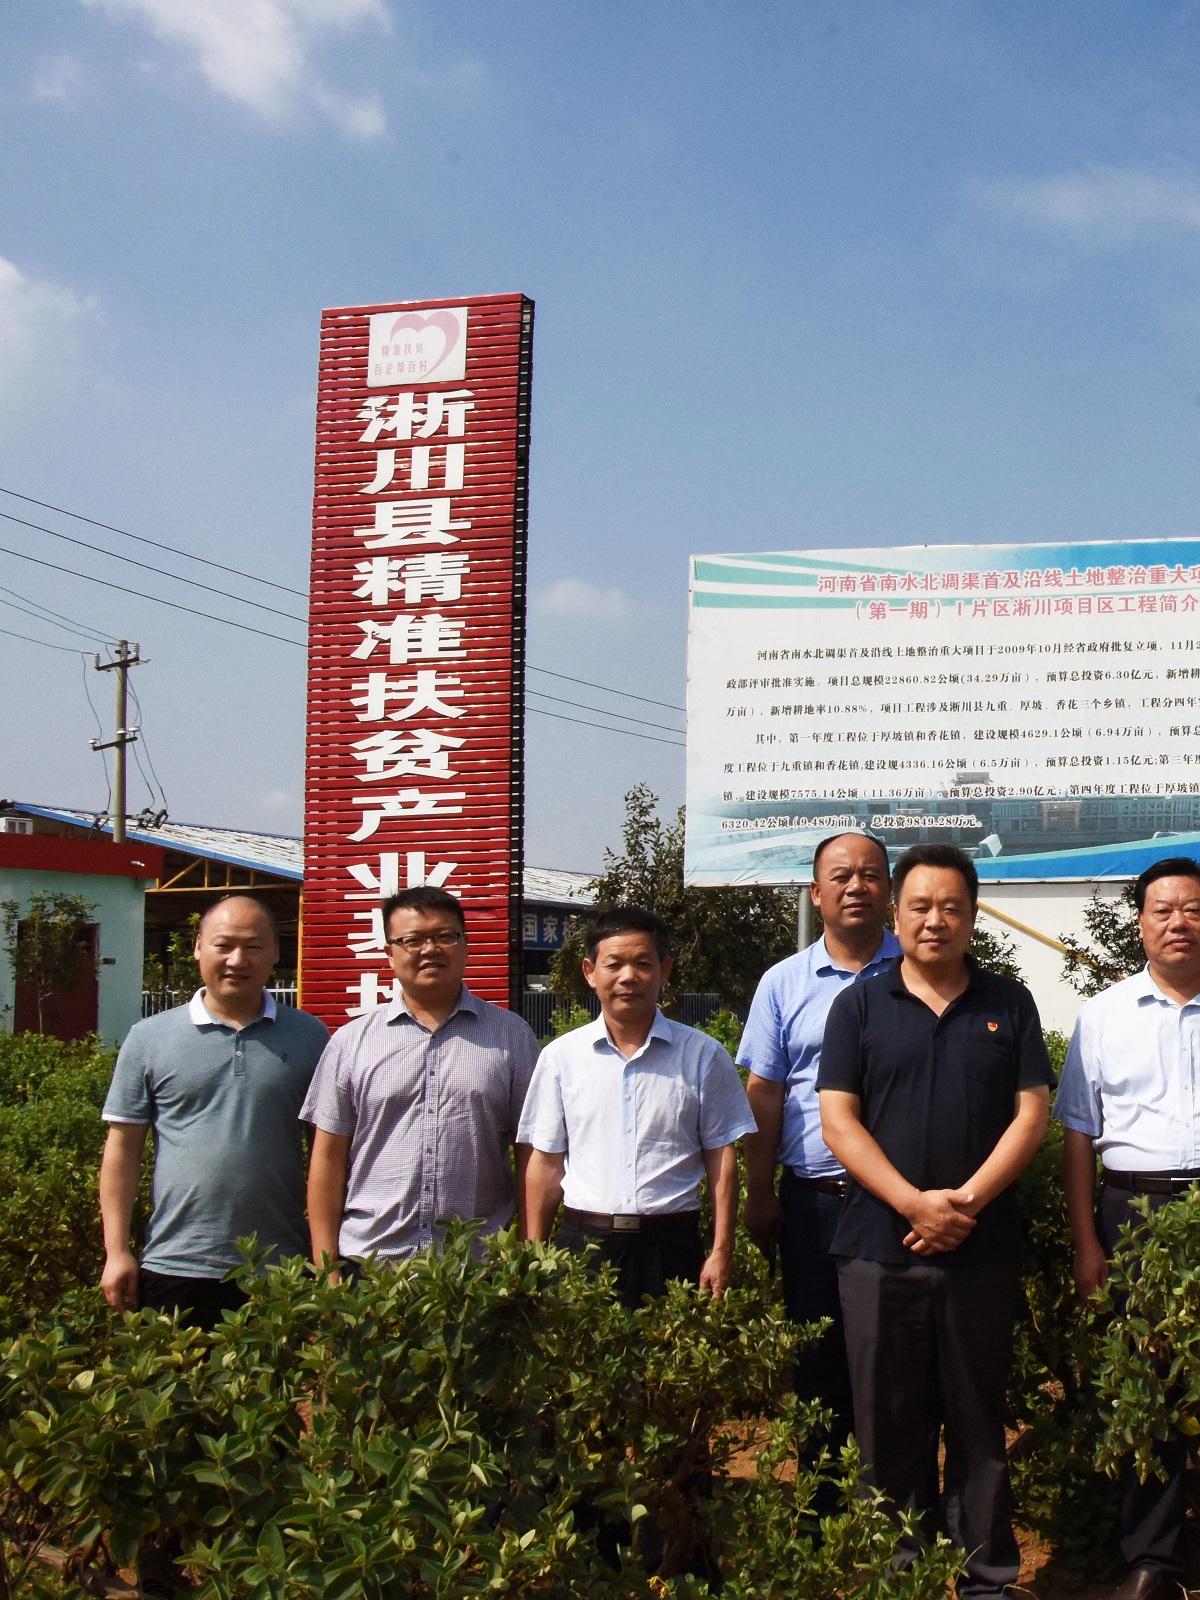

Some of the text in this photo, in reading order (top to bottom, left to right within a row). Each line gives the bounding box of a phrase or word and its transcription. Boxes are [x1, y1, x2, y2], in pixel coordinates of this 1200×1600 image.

[374, 360, 428, 376] 百企帮百村
